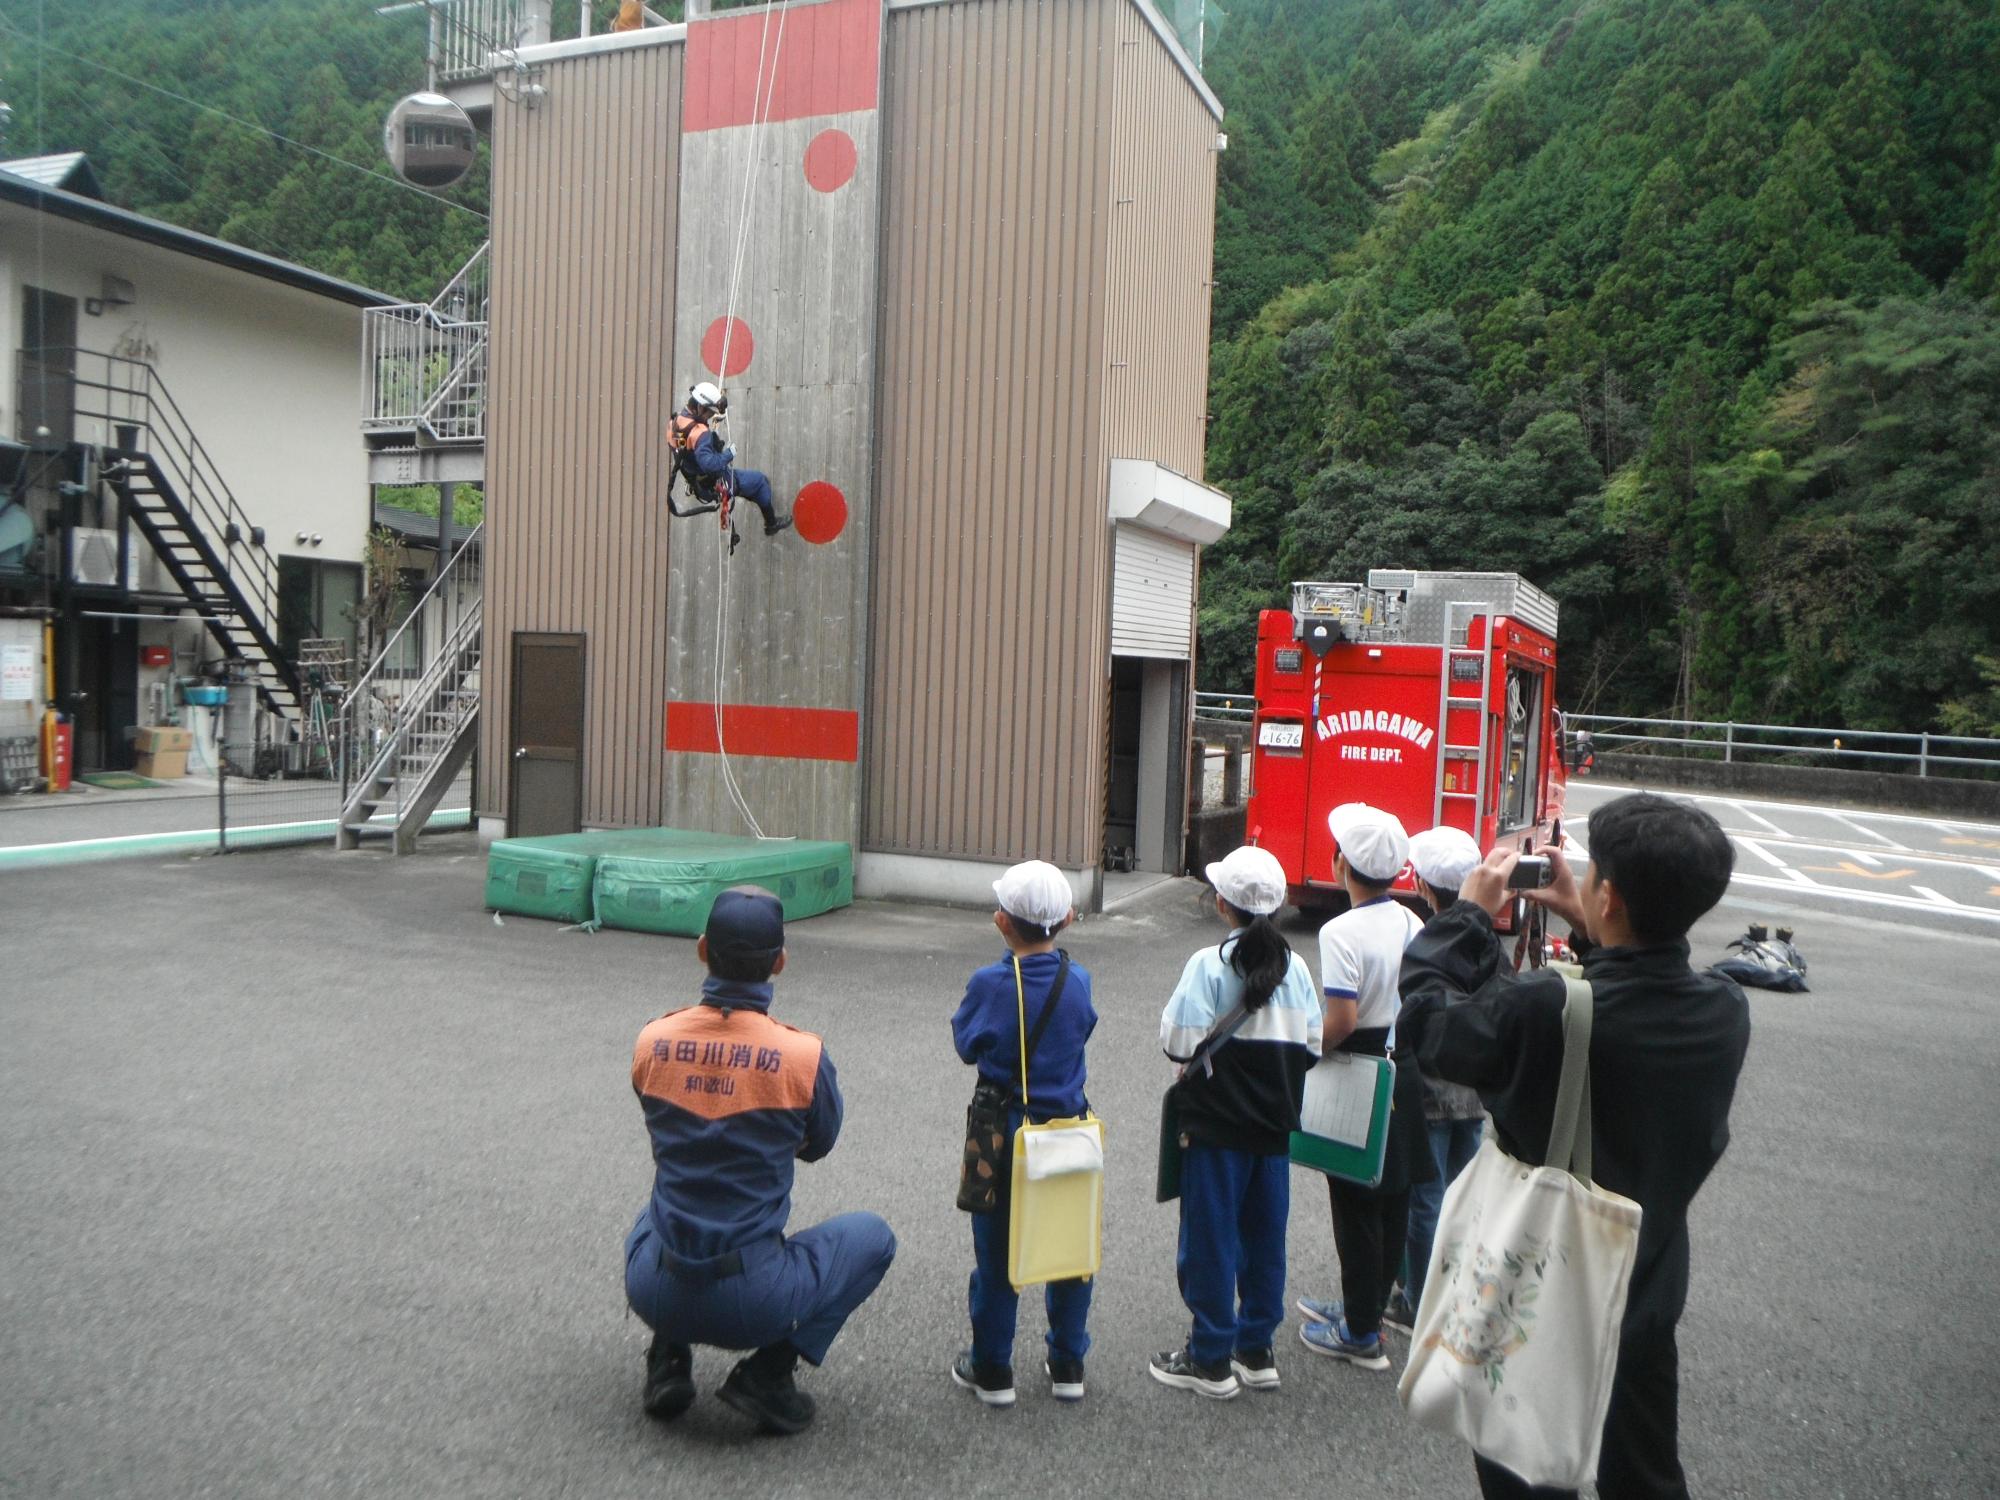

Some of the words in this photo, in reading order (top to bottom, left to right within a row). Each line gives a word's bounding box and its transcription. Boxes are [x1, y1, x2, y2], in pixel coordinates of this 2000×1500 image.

[1270, 732, 1300, 745] 16-76
[1317, 710, 1434, 750] ARIDAGAWA
[1341, 745, 1367, 760] FIRE
[1370, 747, 1402, 763] DEPT.
[653, 1039, 781, 1072] 有田川消防
[685, 1075, 734, 1096] 和歌山
